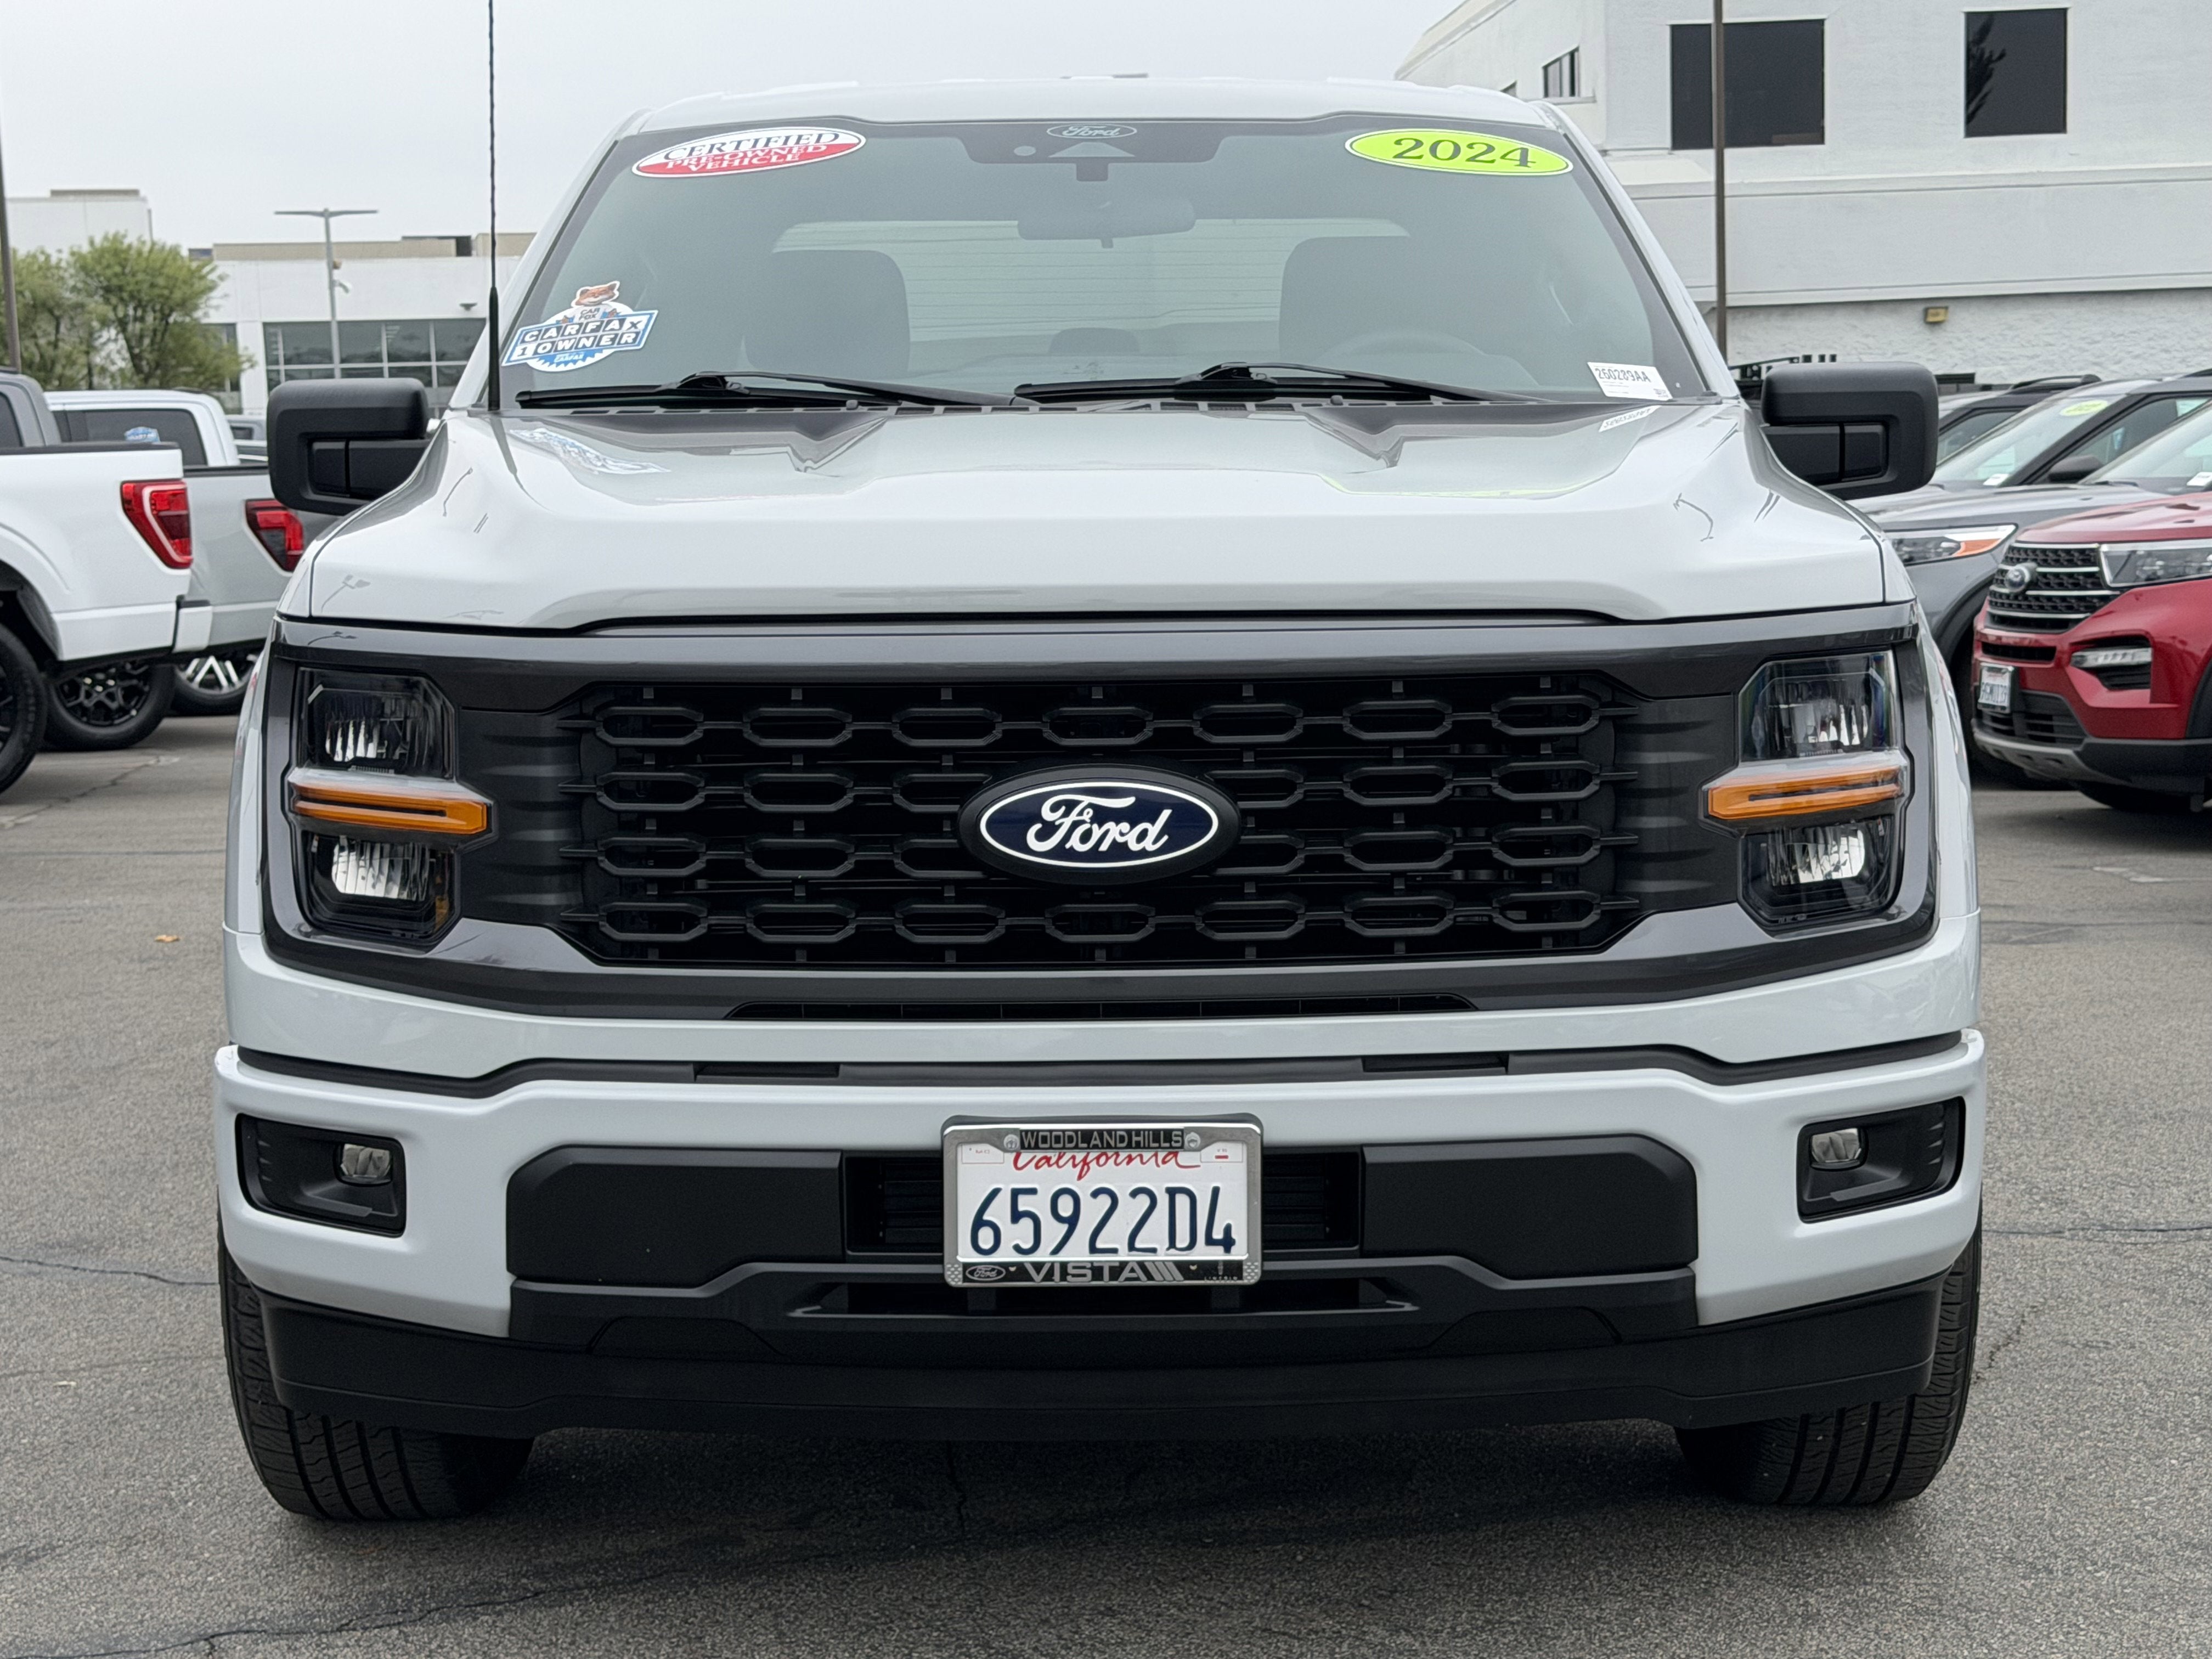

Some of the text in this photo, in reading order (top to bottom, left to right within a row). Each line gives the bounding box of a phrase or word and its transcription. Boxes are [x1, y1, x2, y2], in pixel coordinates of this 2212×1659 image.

[1063, 126, 1120, 136] Ford
[664, 133, 840, 161] CERTIFIED
[667, 144, 828, 169] PRE-OWNED
[1392, 138, 1536, 168] 2024
[688, 153, 800, 172] VEHICLE
[524, 320, 642, 342] CARFAX
[1026, 794, 1172, 852] Ford
[1022, 1130, 1182, 1148] WOODLAND HILLS
[970, 1186, 1236, 1256] 65922D4
[974, 1262, 1148, 1283] Ford VISTA
